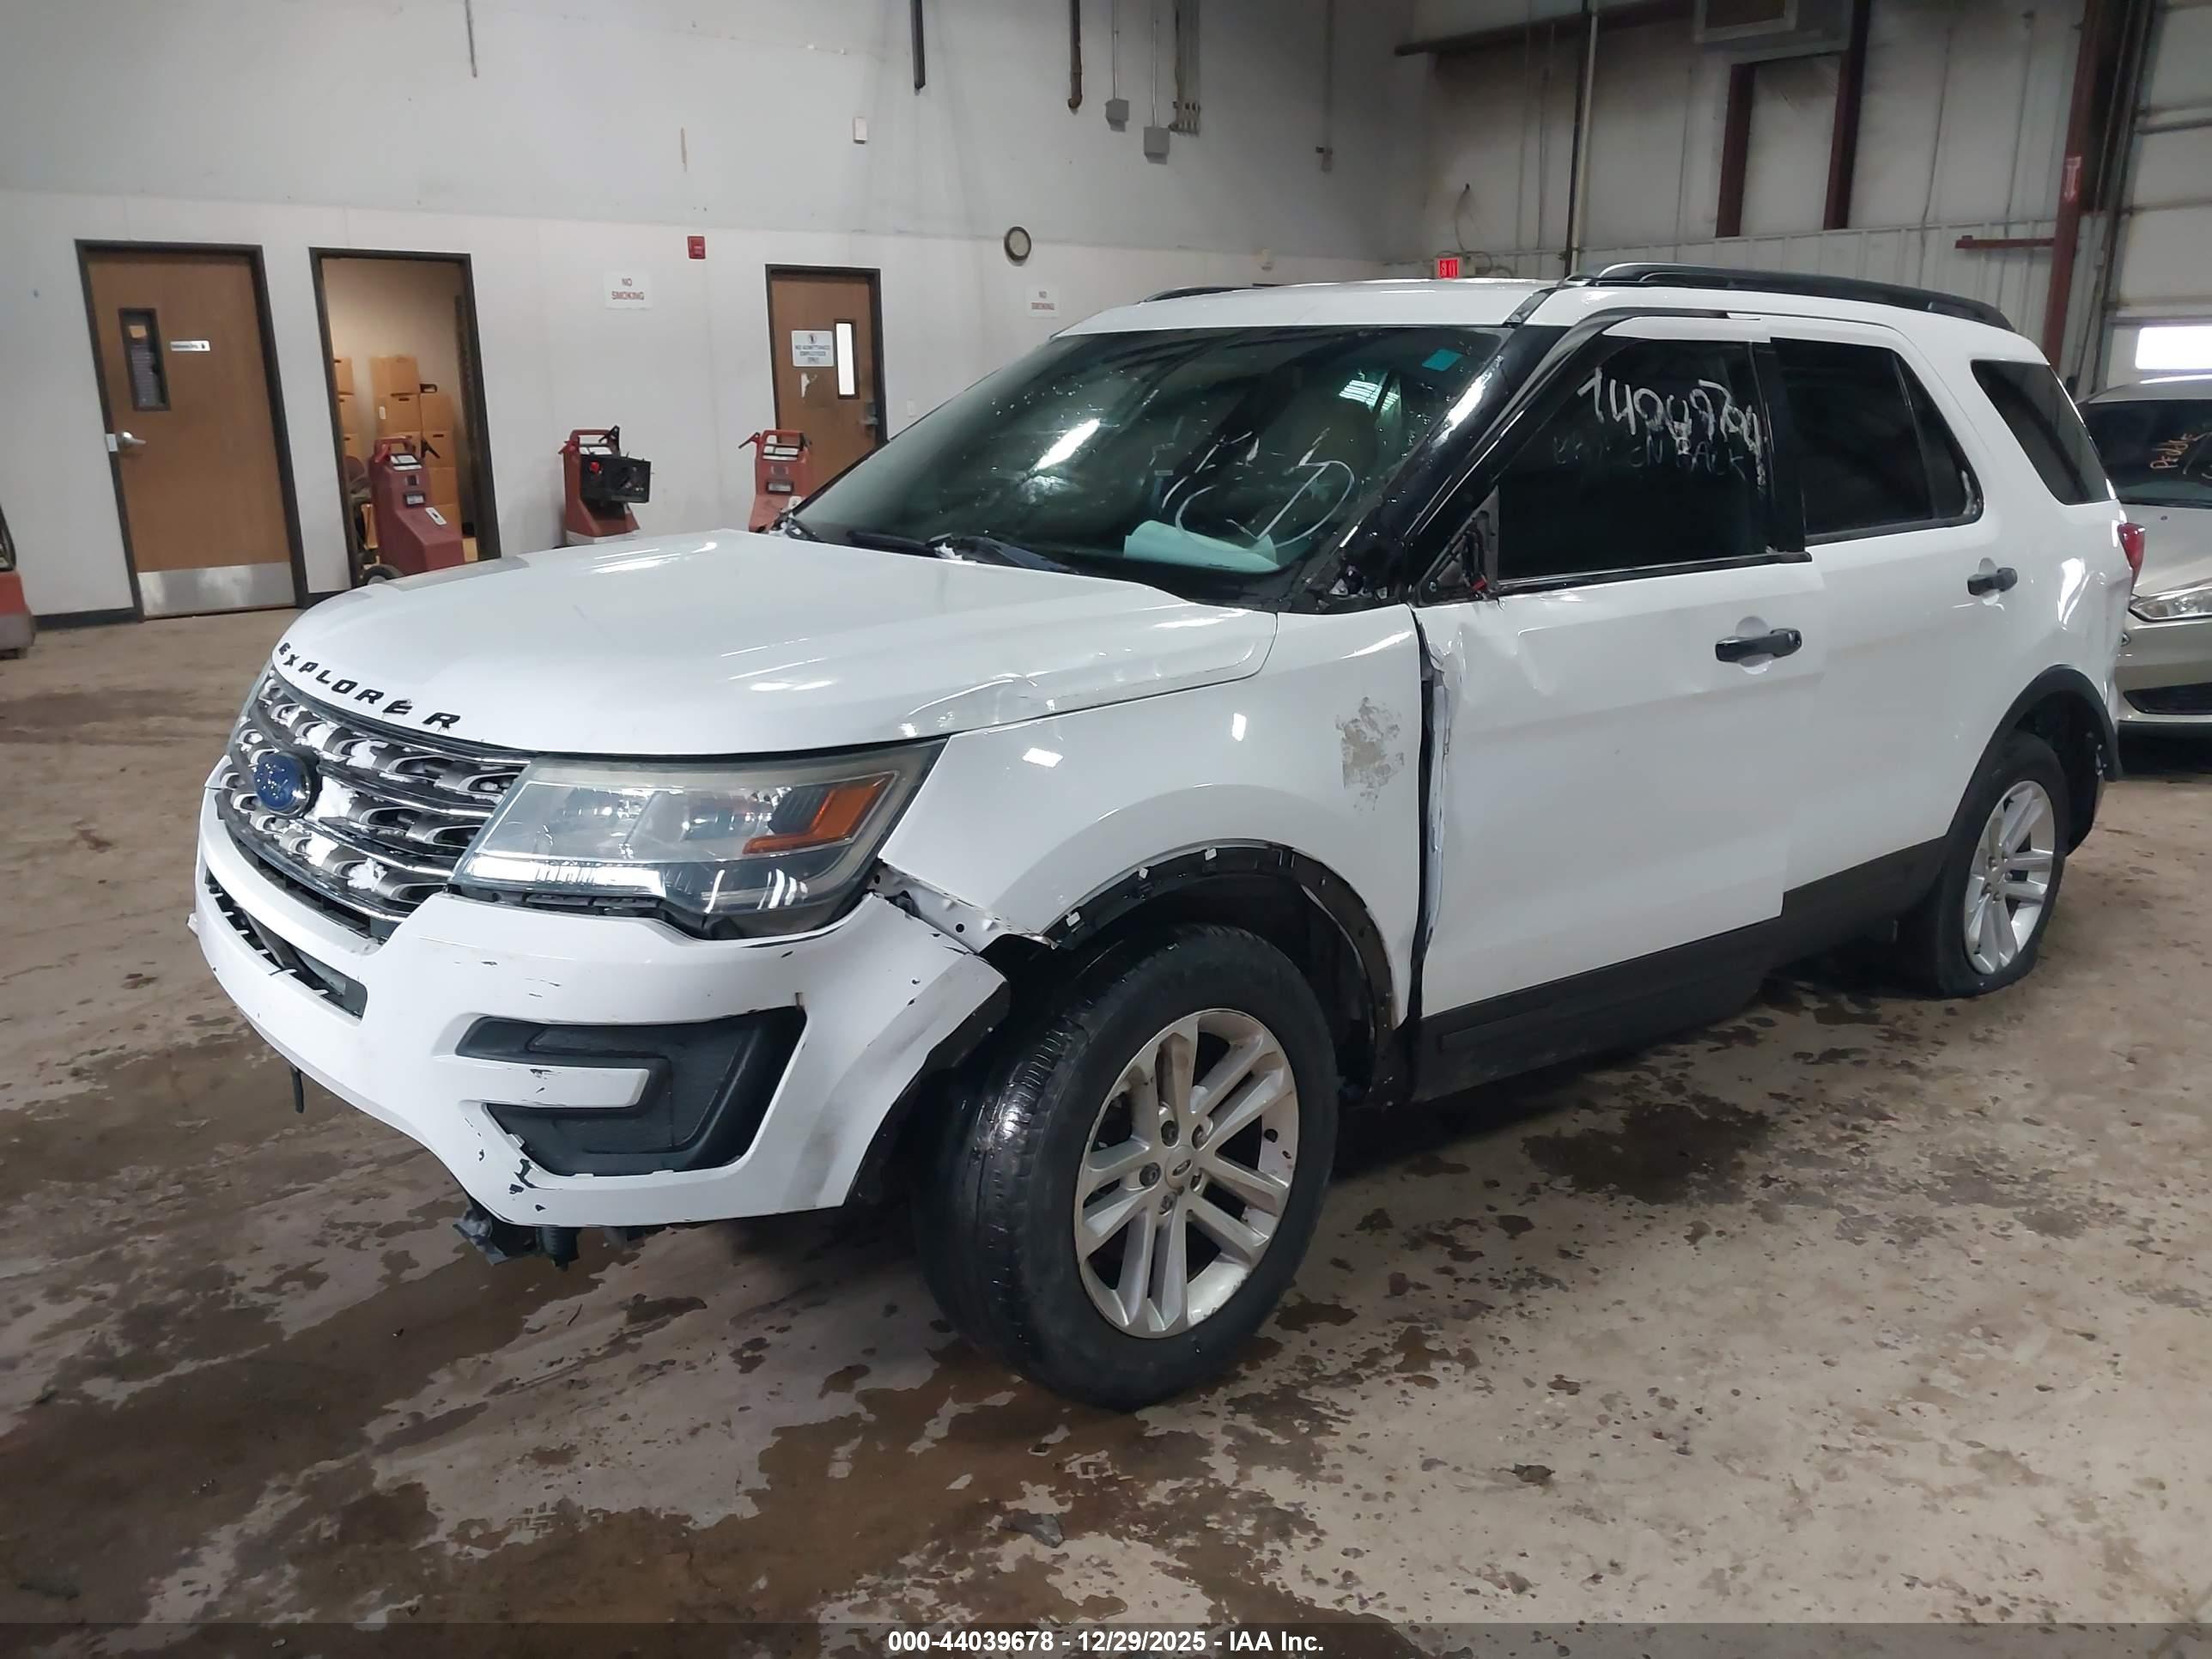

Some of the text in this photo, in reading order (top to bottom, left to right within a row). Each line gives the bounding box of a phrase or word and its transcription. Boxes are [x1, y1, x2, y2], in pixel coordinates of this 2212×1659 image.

[622, 277, 633, 287] NO
[611, 291, 645, 301] SMOKING
[278, 642, 461, 729] EXPLORER
